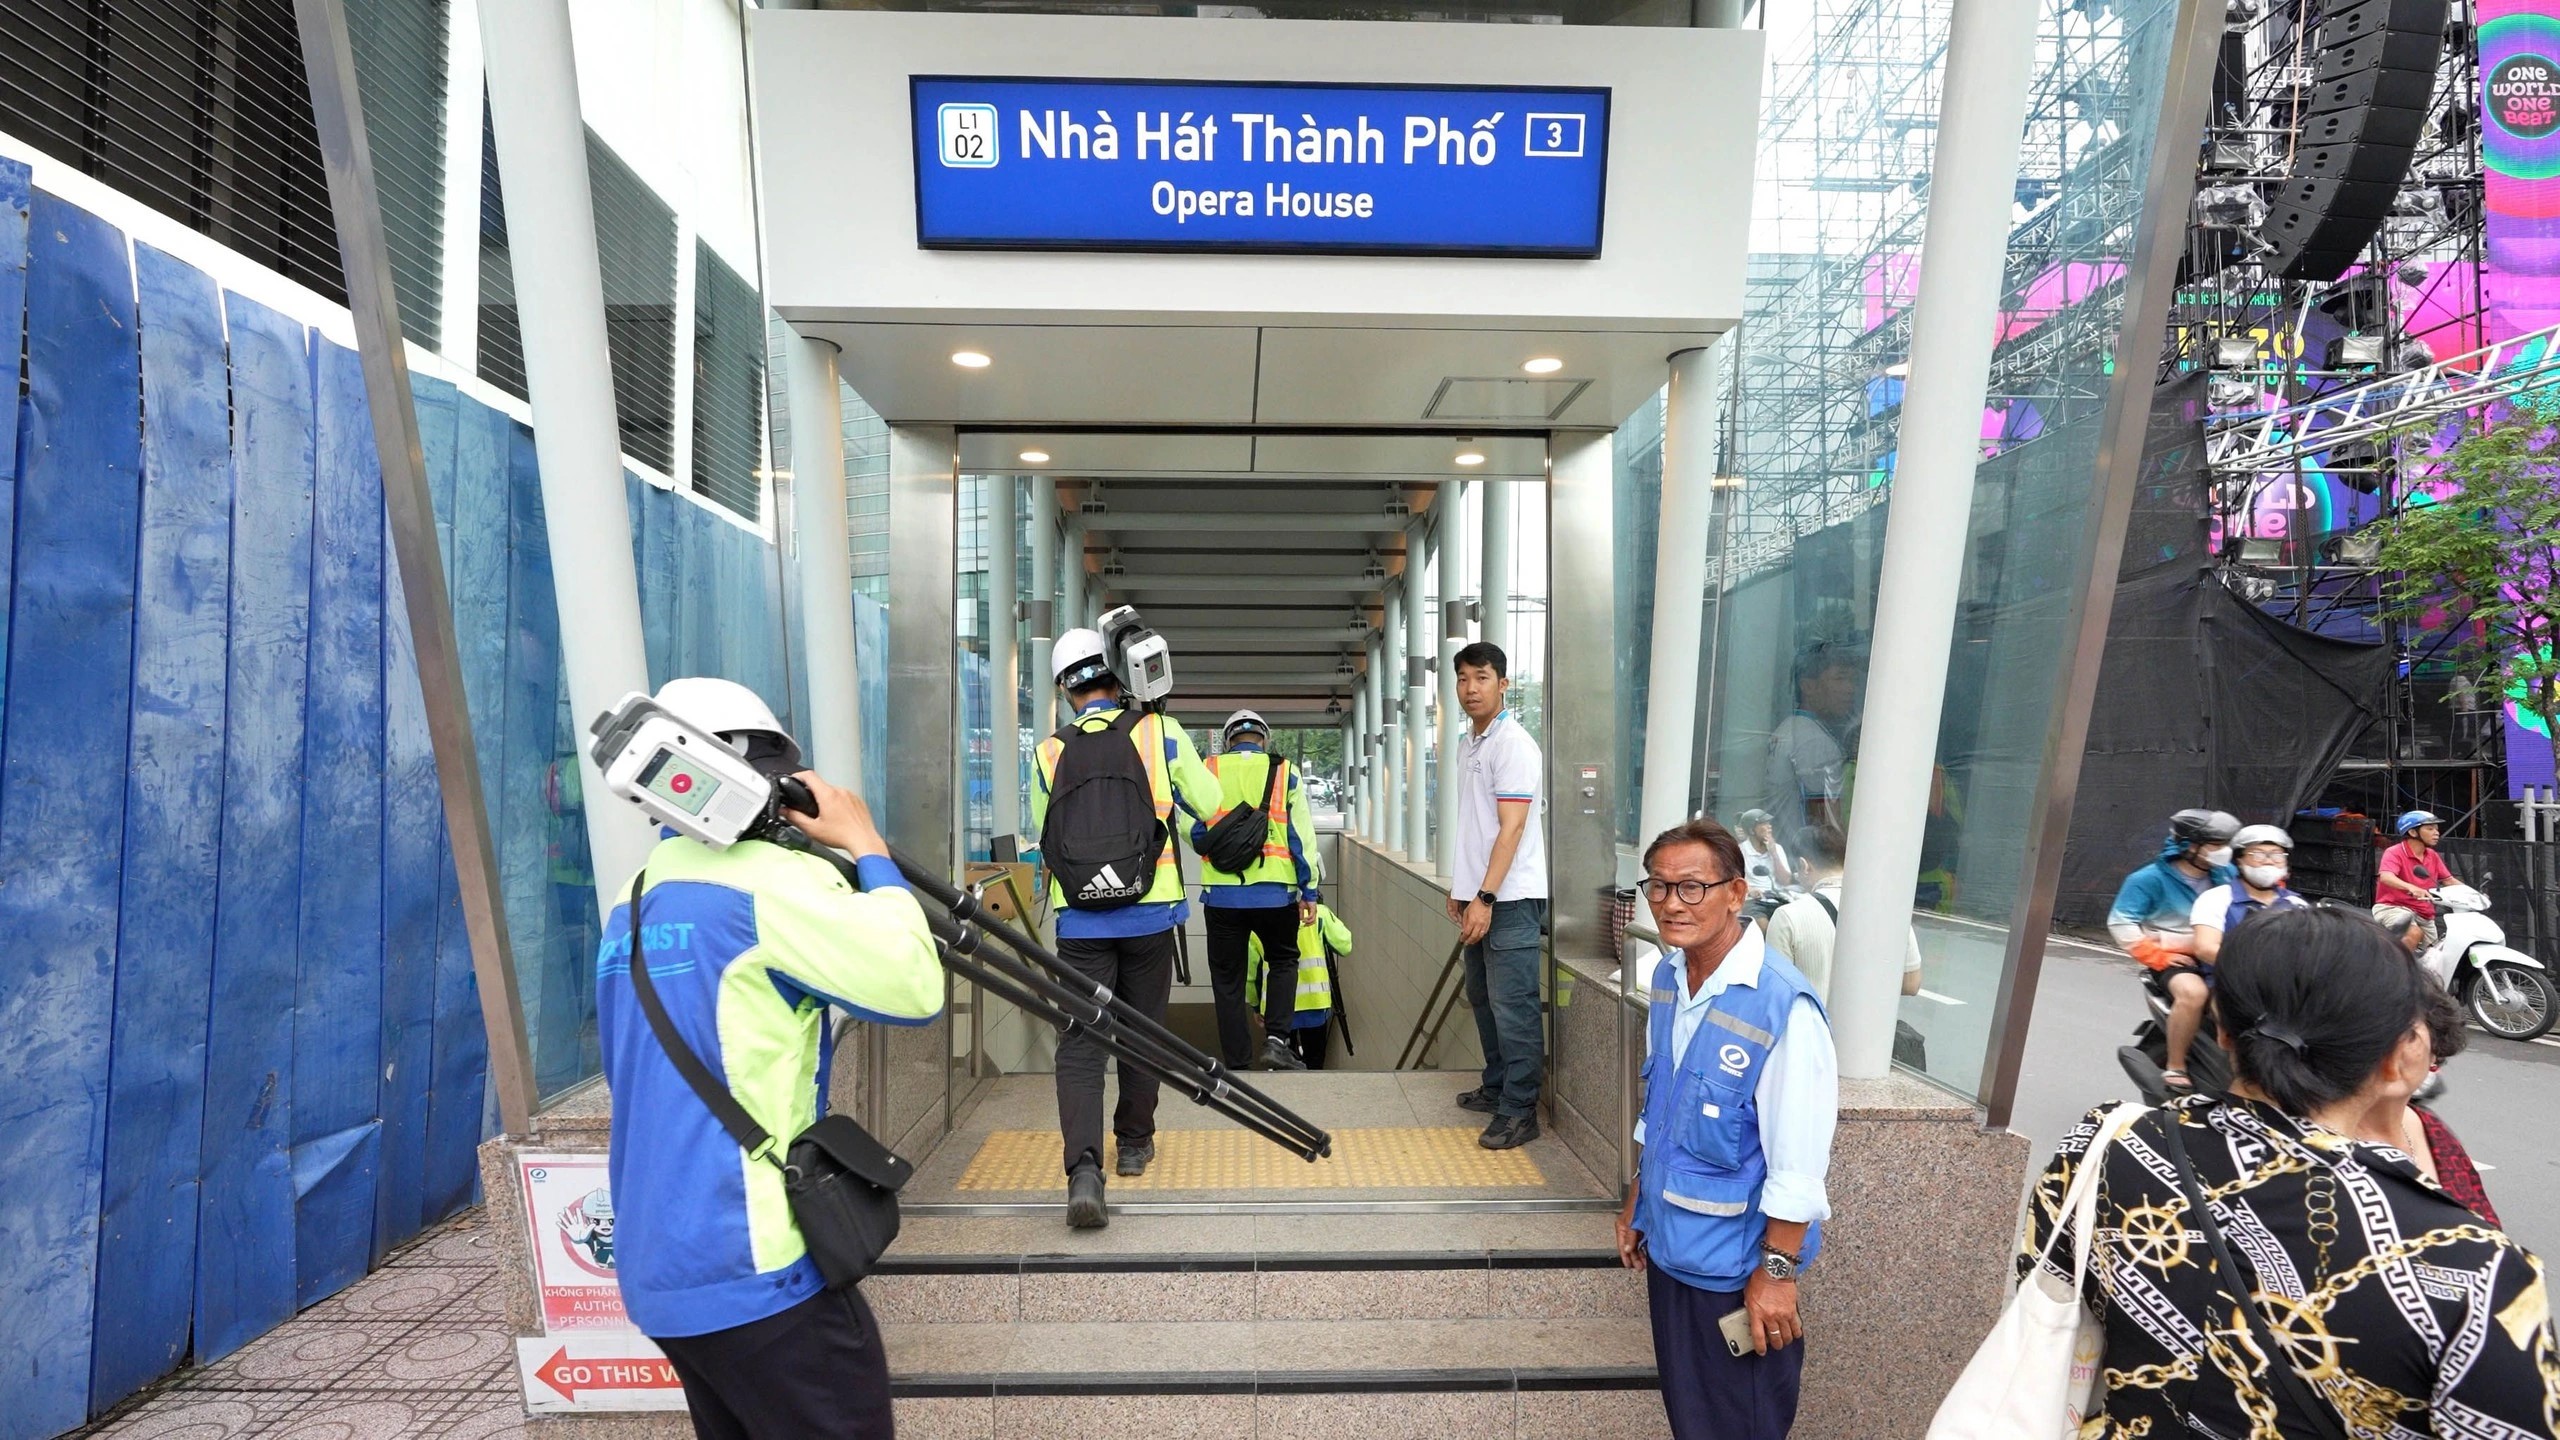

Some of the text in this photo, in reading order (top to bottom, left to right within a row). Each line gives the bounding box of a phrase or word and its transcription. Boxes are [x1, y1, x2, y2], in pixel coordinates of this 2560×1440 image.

[959, 112, 977, 130] L1
[1019, 110, 1505, 166] Nhà Hát Thành Phố
[1546, 122, 1563, 149] 3
[954, 134, 984, 159] 02
[1152, 180, 1374, 224] Opera House
[1078, 886, 1136, 900] adidas
[545, 1286, 584, 1298] KHÔNG
[574, 1300, 623, 1311] AUTHO
[553, 1366, 592, 1384] GO
[597, 1365, 653, 1383] THIS
